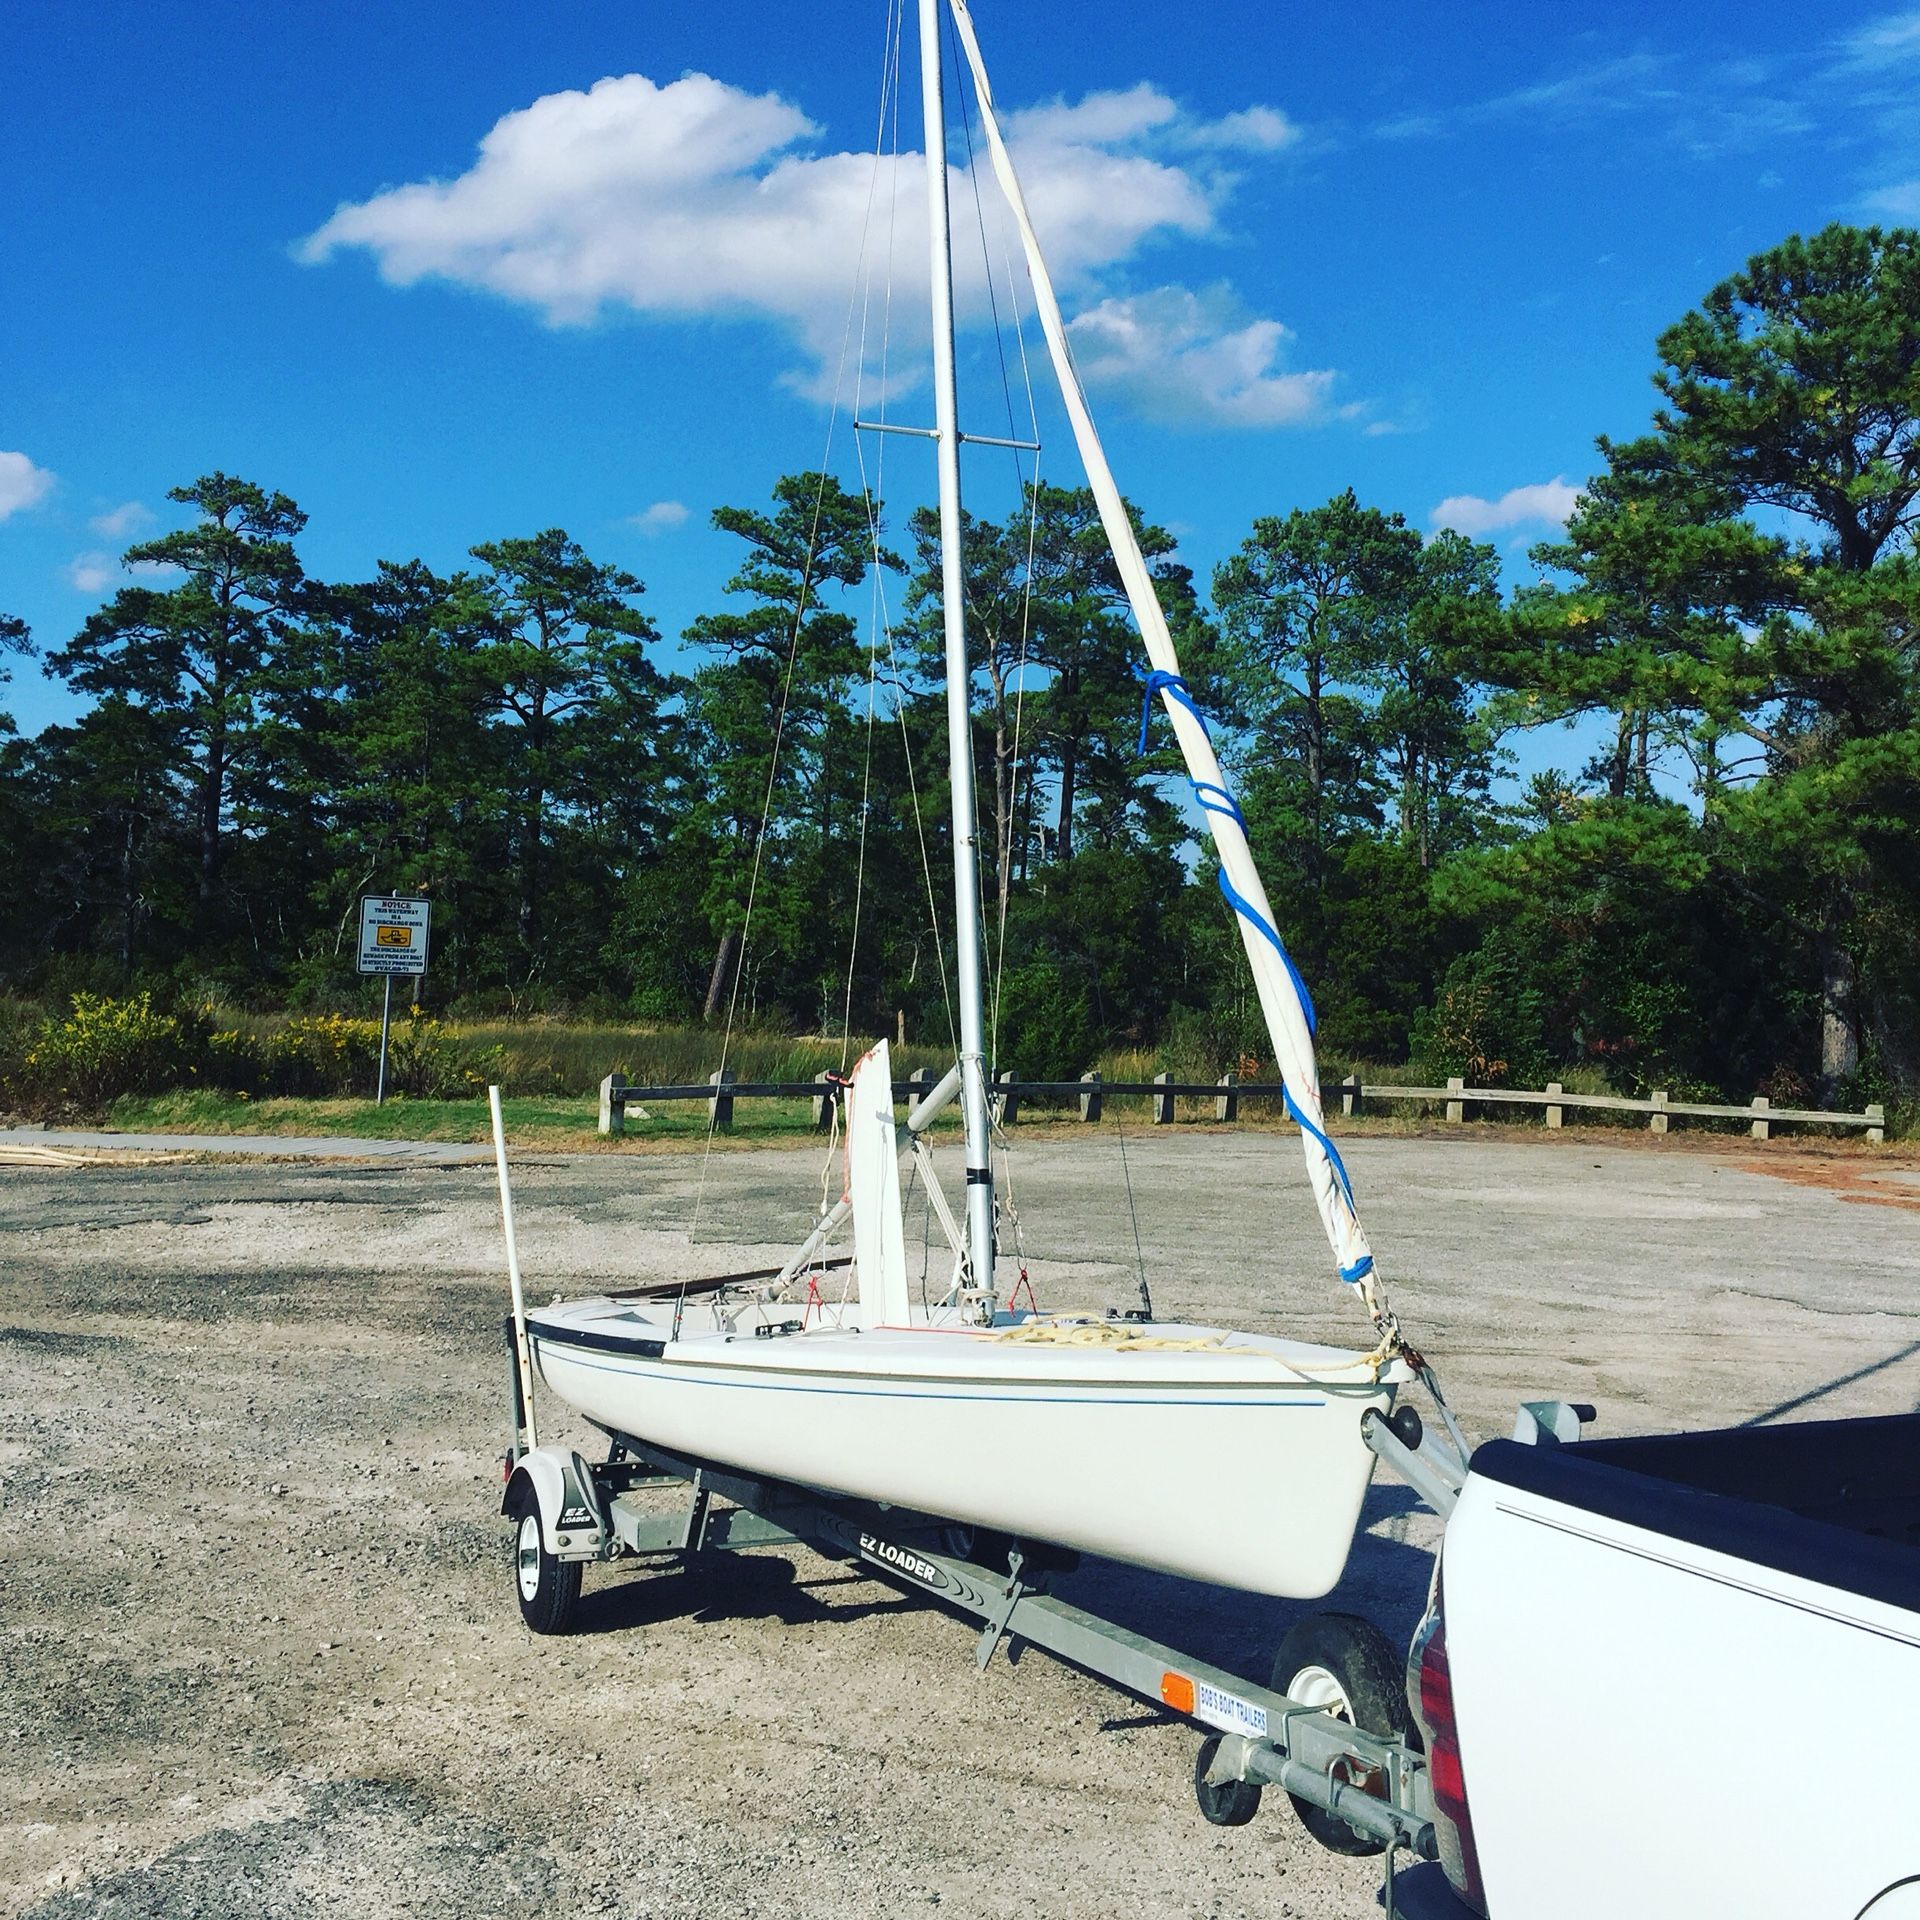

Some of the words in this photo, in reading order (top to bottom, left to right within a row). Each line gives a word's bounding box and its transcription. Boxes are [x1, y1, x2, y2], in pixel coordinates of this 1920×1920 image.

[382, 900, 411, 909] NOTICE
[565, 1507, 586, 1516] EZ
[561, 1516, 591, 1524] LOADER
[859, 1532, 877, 1552] EZ
[878, 1541, 937, 1583] LOADER
[1201, 1686, 1218, 1710] BOB'S
[1219, 1694, 1235, 1717] BOAT
[1236, 1702, 1266, 1732] TRAILERS
